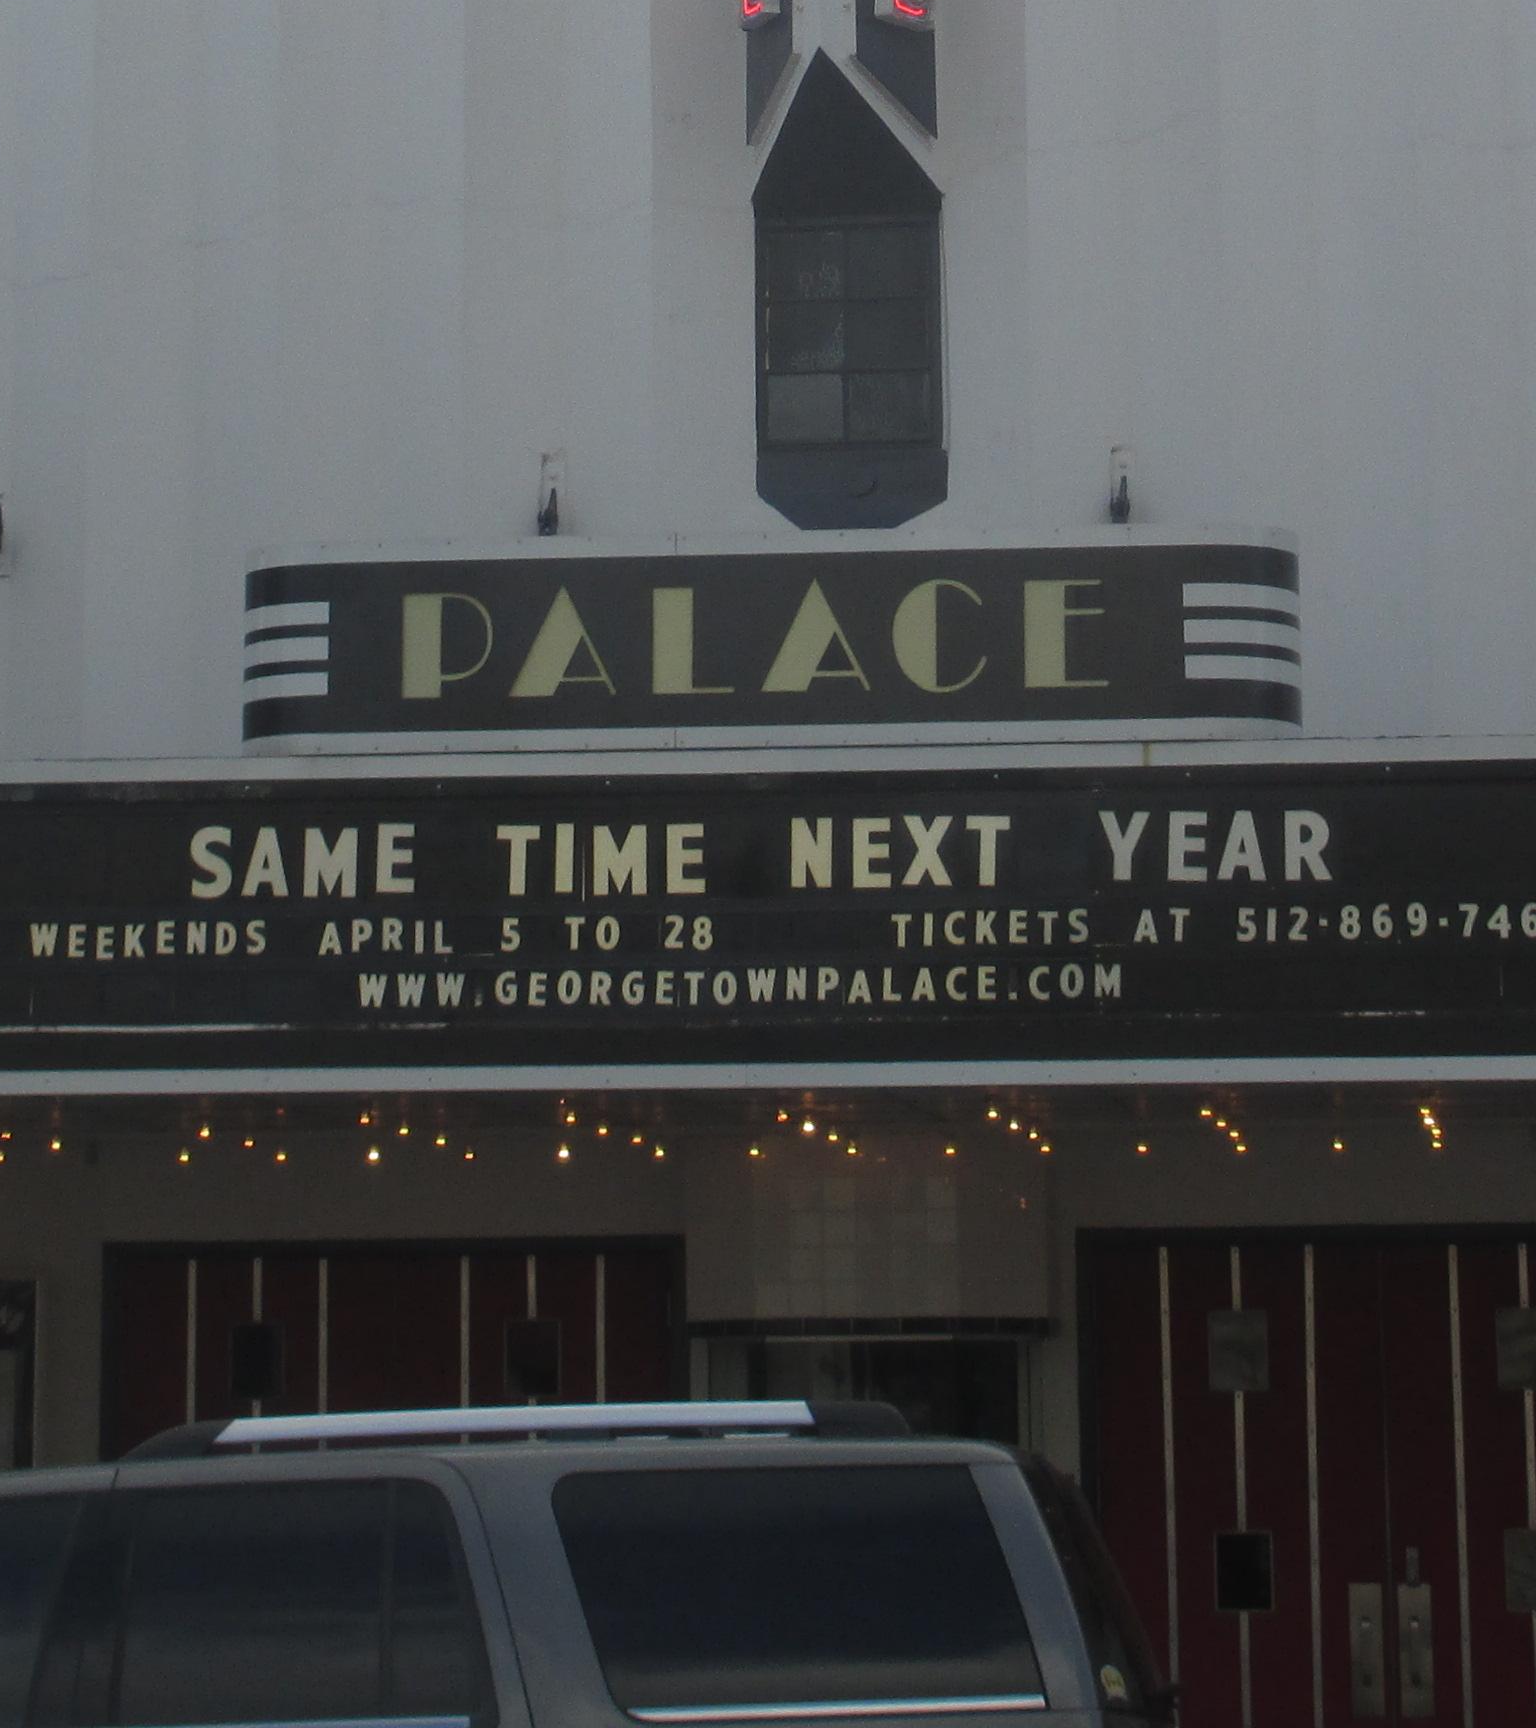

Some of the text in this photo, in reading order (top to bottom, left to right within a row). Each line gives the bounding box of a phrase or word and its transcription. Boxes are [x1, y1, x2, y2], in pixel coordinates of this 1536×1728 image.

[400, 577, 1111, 700] PALACE
[190, 808, 1333, 899] SAME TIME NEXT YEAR
[29, 919, 267, 961] WEEKENDS
[318, 917, 454, 957] APRIL
[499, 916, 522, 953] 5
[564, 914, 621, 952] TO
[663, 914, 715, 952] 28
[890, 907, 1090, 948] TICKETS
[1133, 907, 1191, 944] AT
[358, 962, 1123, 1009] WWW.GEORGETOWNPALACE.COM
